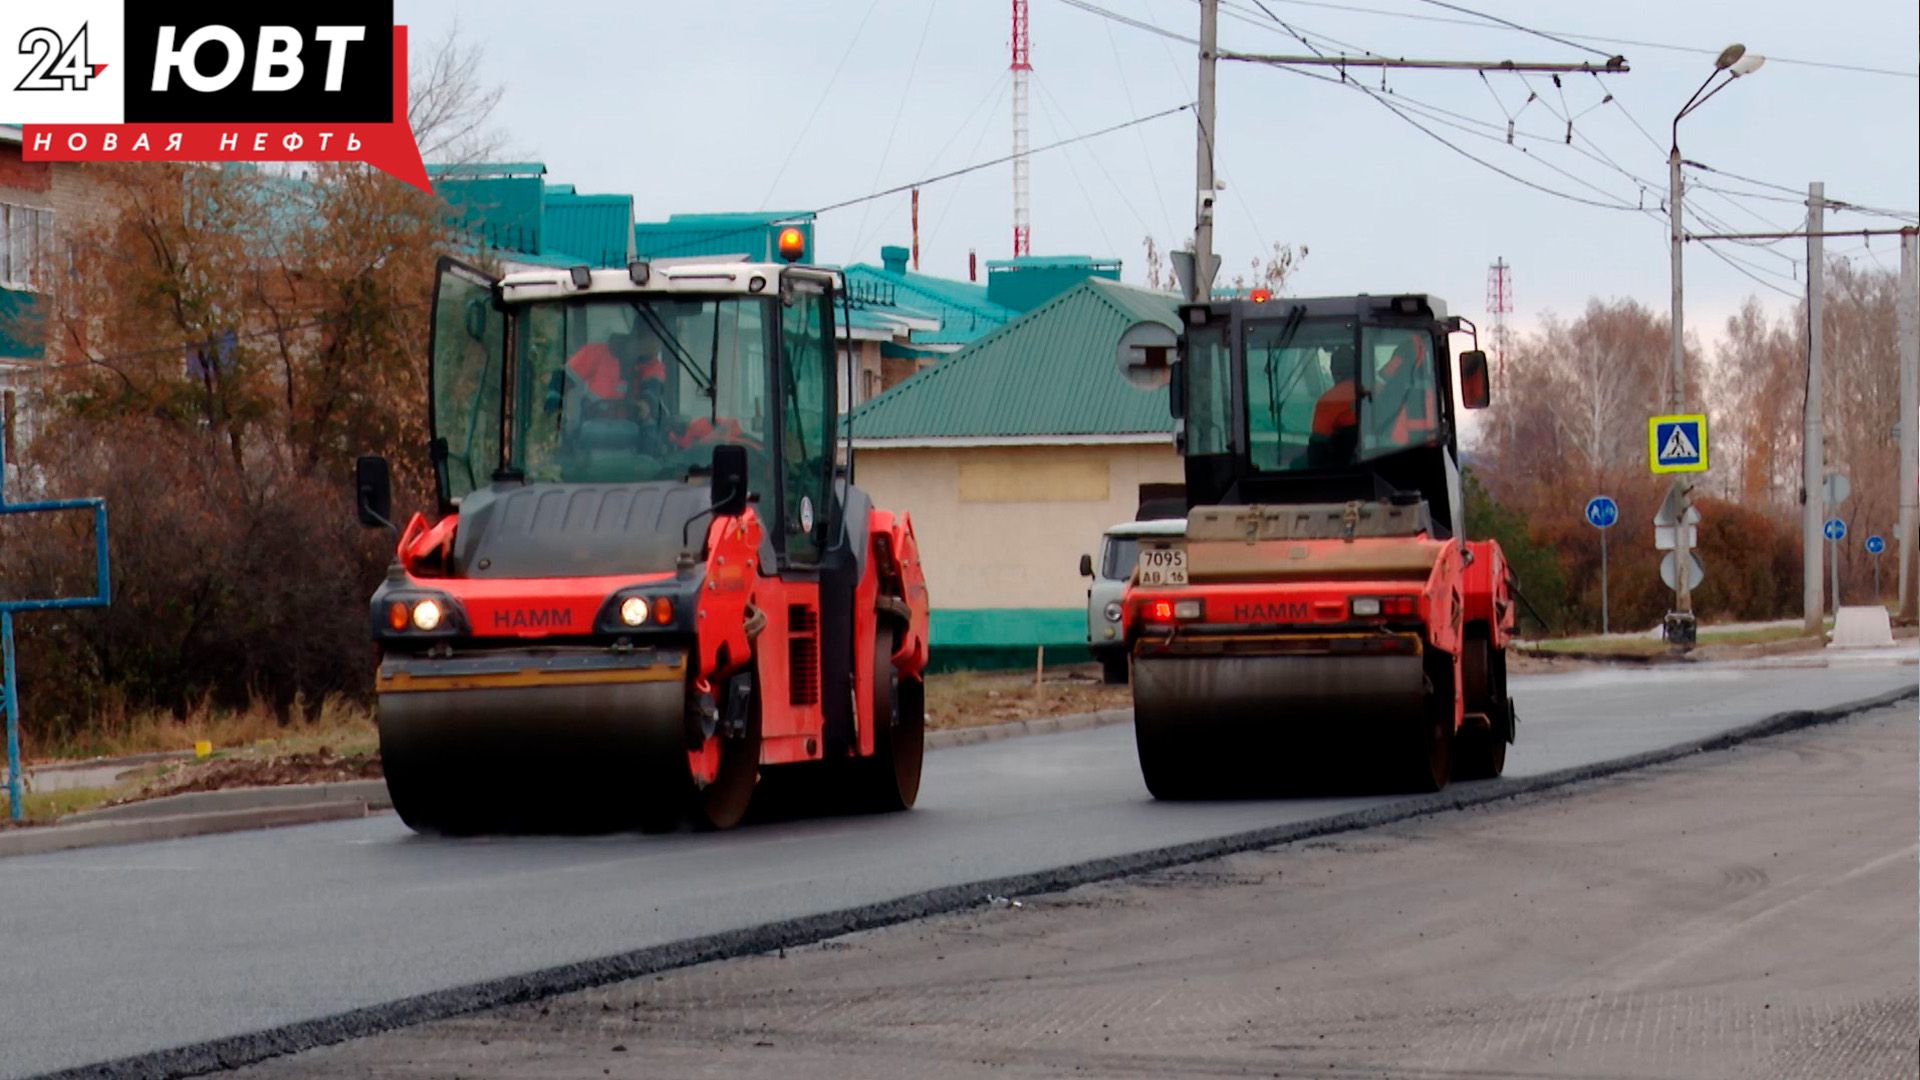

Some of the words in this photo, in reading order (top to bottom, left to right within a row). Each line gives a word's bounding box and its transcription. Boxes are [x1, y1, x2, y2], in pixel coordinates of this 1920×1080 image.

[1144, 551, 1183, 567] 7095
[1170, 571, 1184, 583] 16
[493, 608, 572, 628] HAMM
[1233, 602, 1308, 621] HAMM
